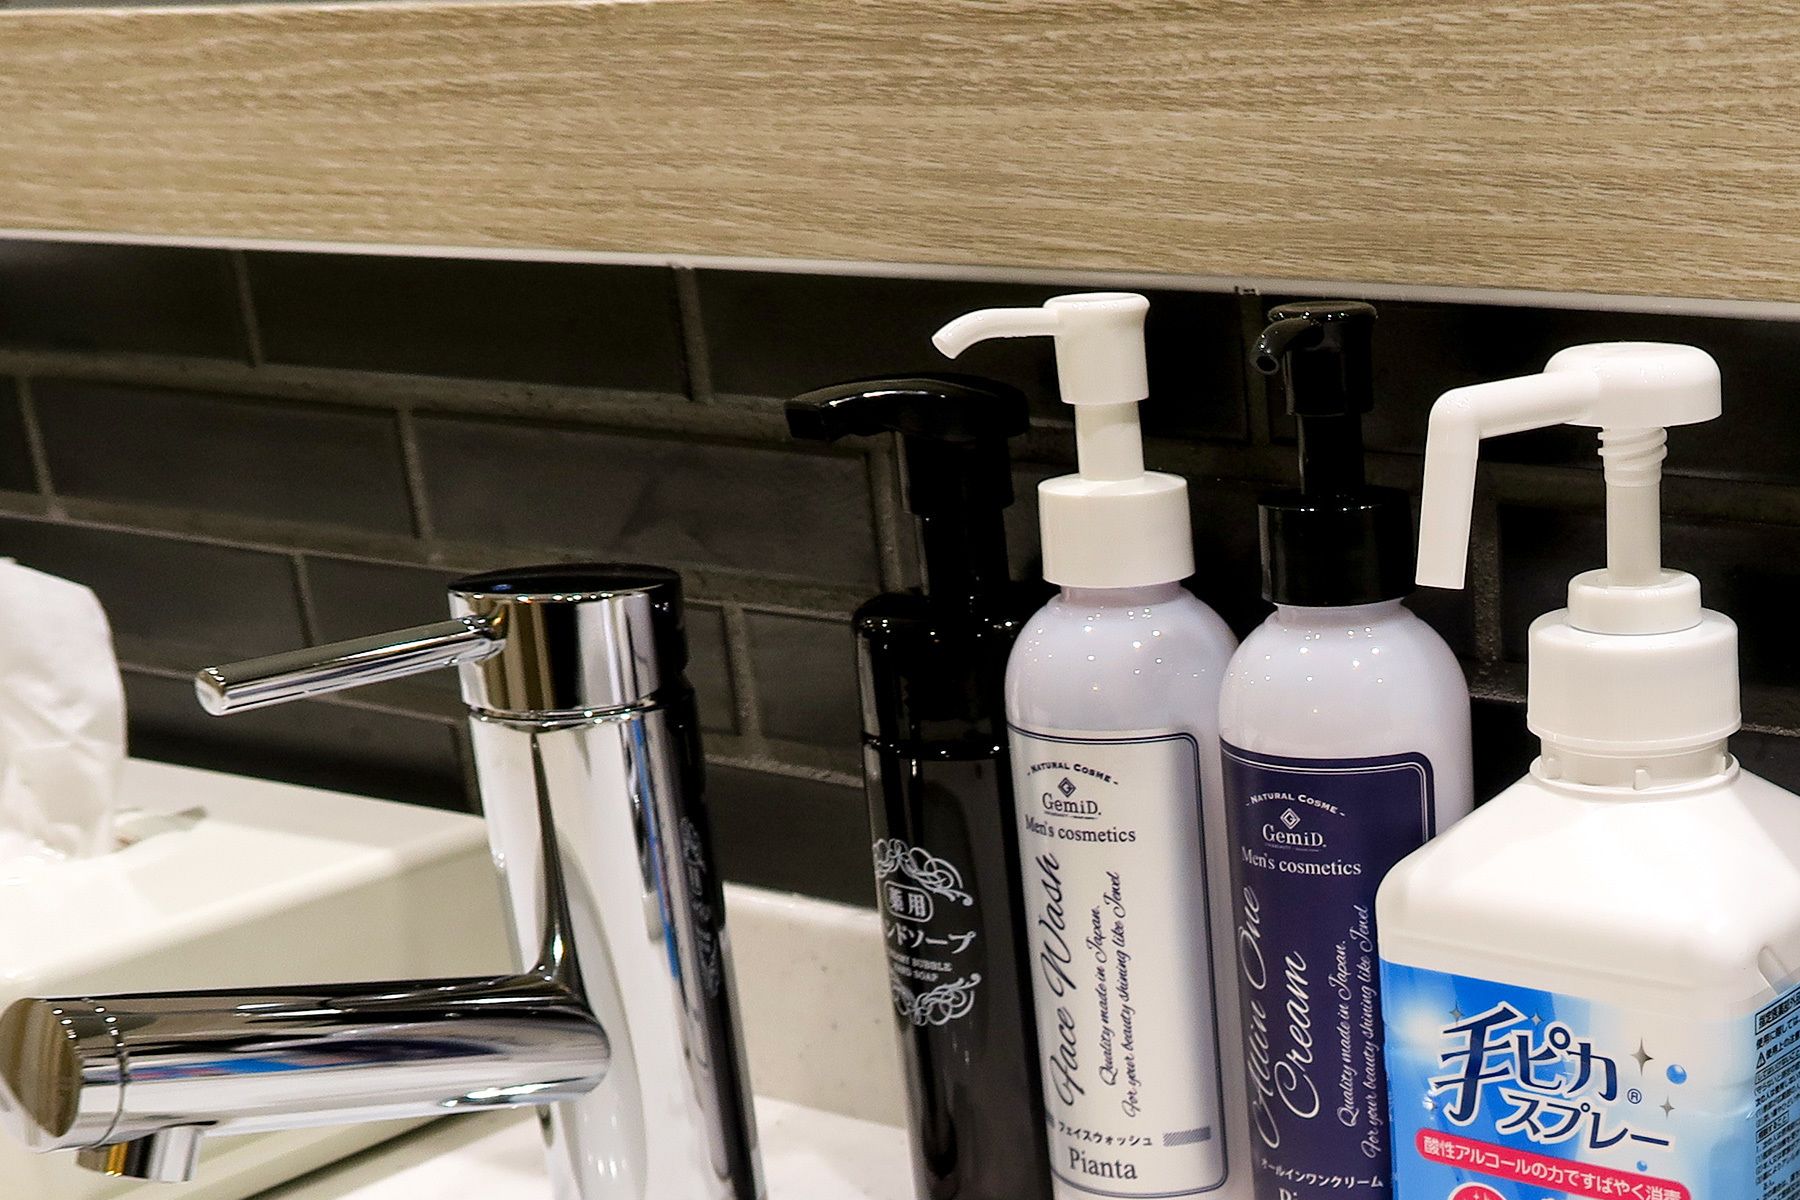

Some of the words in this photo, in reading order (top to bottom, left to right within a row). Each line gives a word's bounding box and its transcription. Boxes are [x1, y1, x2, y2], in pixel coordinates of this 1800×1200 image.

[1030, 761, 1071, 774] NATURAL
[1073, 763, 1112, 783] COSME
[1250, 792, 1295, 805] NATURAL
[1297, 794, 1338, 815] COSME
[1025, 814, 1055, 838] Men's
[1058, 827, 1136, 843] cosmetics
[1241, 846, 1275, 870] Men's
[1278, 859, 1362, 876] cosmetics
[888, 886, 927, 918] 薬用
[1103, 870, 1126, 919] Jewel
[1036, 852, 1078, 998] Wash
[1111, 920, 1126, 948] like
[1238, 886, 1267, 990] One
[1350, 904, 1374, 952] Jewel
[1096, 965, 1107, 982] in
[1115, 950, 1131, 1002] shining
[1328, 940, 1352, 1000] Japan.
[1355, 954, 1373, 984] like
[1097, 983, 1111, 1024] made
[1336, 1003, 1349, 1019] in
[1359, 984, 1378, 1040] shining
[1119, 1003, 1137, 1052] beauty
[1274, 951, 1320, 1119] Cream
[1335, 1022, 1352, 1066] made
[1050, 1006, 1086, 1106] Face
[1099, 1023, 1119, 1086] Quality
[1121, 1054, 1142, 1087] your
[1360, 1041, 1380, 1094] beauty
[1433, 1006, 1618, 1122] 手ピカ
[1121, 1086, 1140, 1118] For
[1337, 1067, 1360, 1128] Quality
[1362, 1094, 1384, 1128] your
[1058, 1121, 1153, 1147] フェイスウォッシュ
[1501, 1093, 1670, 1149] スプレー
[1068, 1147, 1139, 1180] Pianta
[1361, 1128, 1383, 1159] For
[1261, 1158, 1384, 1189] オールインワンクリーム
